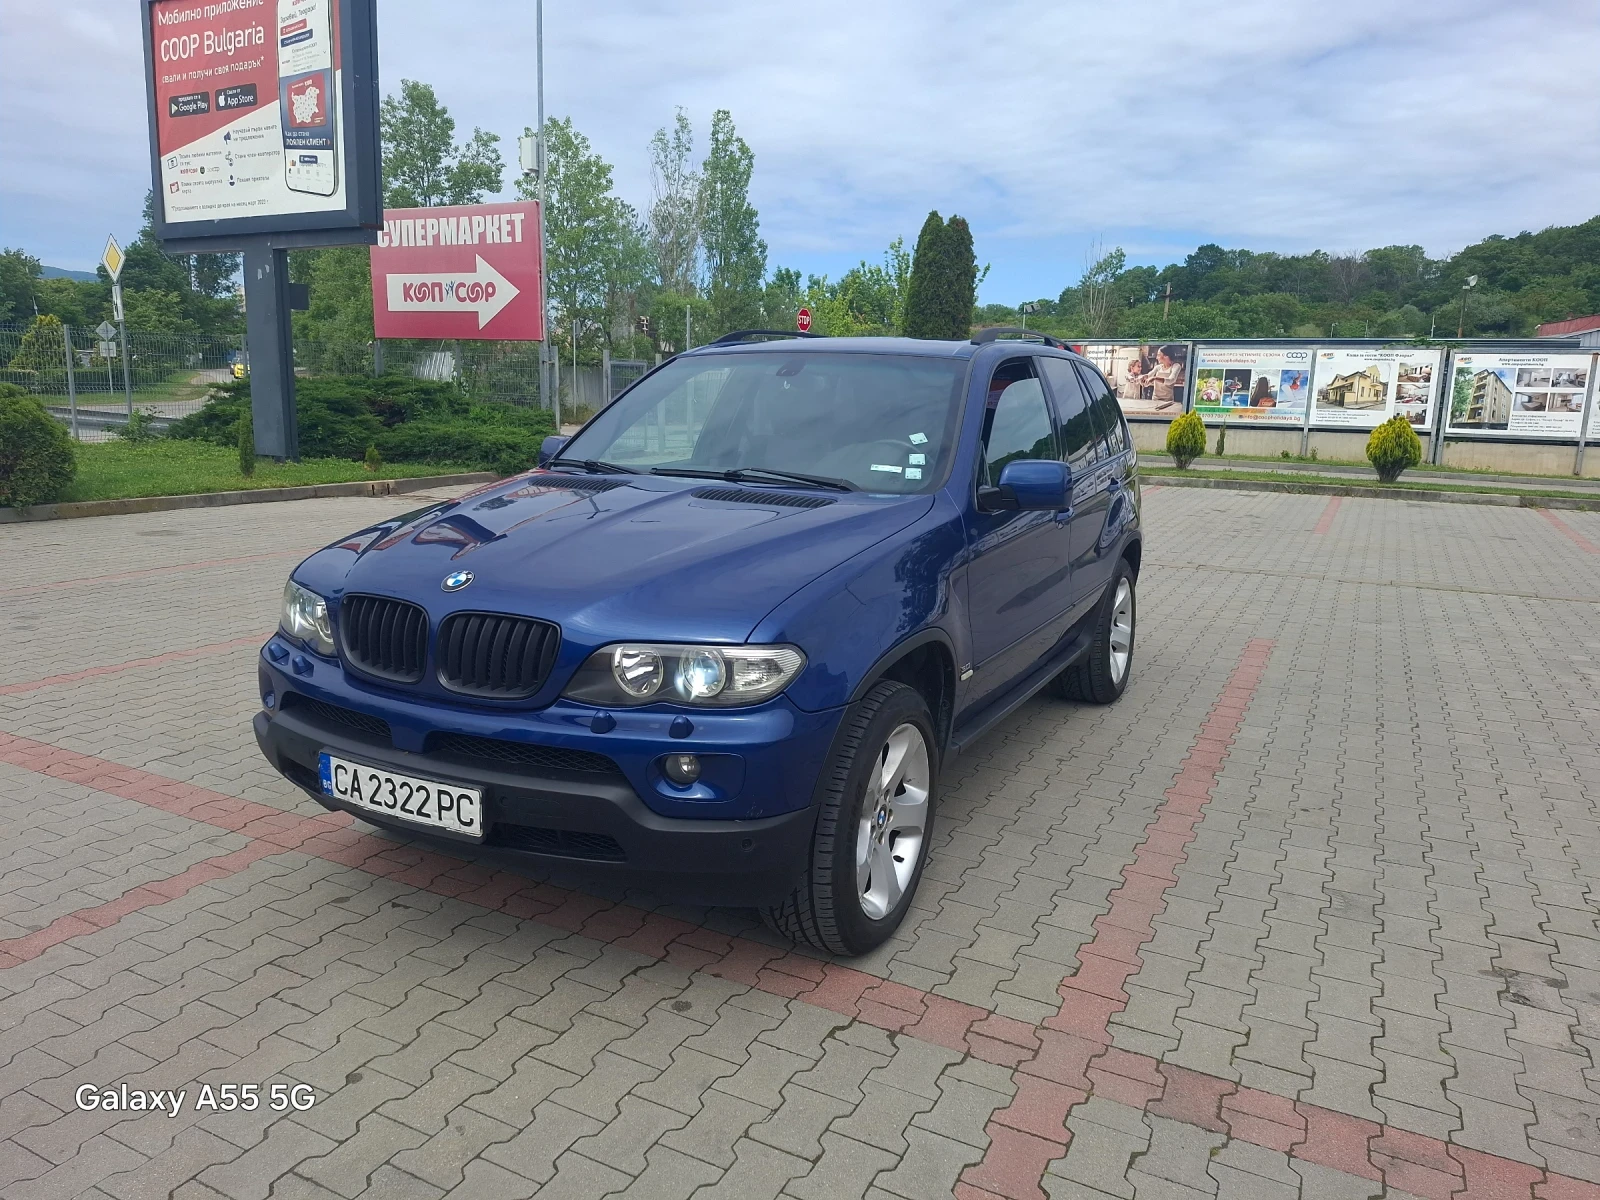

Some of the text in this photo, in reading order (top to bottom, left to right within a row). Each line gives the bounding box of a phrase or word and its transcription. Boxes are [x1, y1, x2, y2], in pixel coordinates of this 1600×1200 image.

[158, 8, 202, 26] Мобилно
[160, 21, 265, 62] COOP Bulgaria
[161, 74, 181, 84] свали
[188, 68, 213, 80] получи
[214, 65, 230, 76] своя
[178, 100, 208, 113] Google Play
[227, 94, 254, 107] App Store
[305, 138, 327, 146] КЛИЕНТ
[377, 213, 525, 248] СУПЕРМАРКЕТ
[798, 315, 810, 325] STOP
[323, 779, 332, 790] BG
[334, 764, 474, 827] CA 2322 PC
